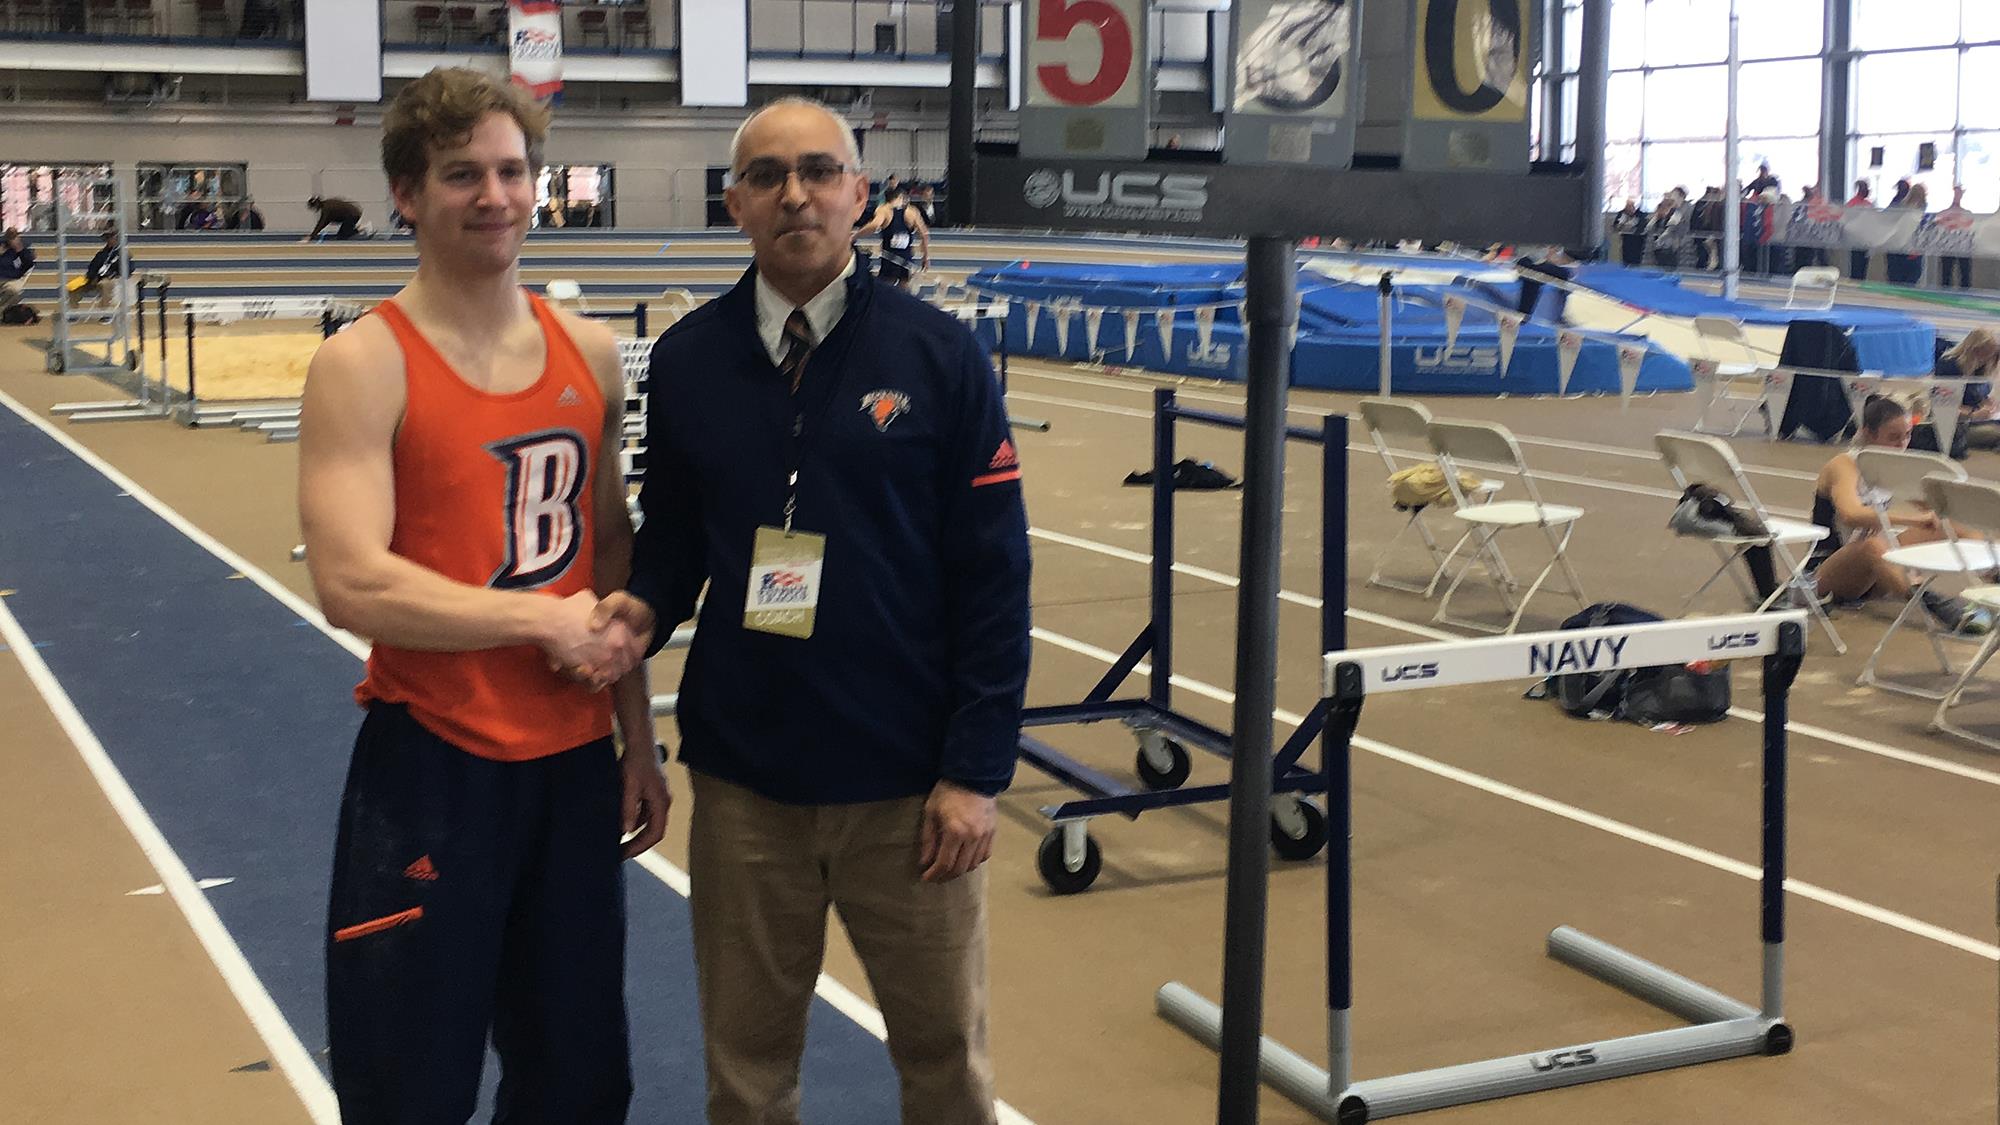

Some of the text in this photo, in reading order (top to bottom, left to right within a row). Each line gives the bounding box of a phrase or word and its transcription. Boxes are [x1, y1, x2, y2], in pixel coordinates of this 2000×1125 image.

[1036, 0, 1134, 106] 5
[1062, 168, 1209, 209] UCS
[1415, 345, 1499, 368] UCS
[484, 426, 589, 592] B
[1528, 633, 1631, 676] NAVY
[1707, 631, 1761, 651] UCS
[1381, 662, 1440, 683] UCS
[1529, 1047, 1598, 1072] UCS
